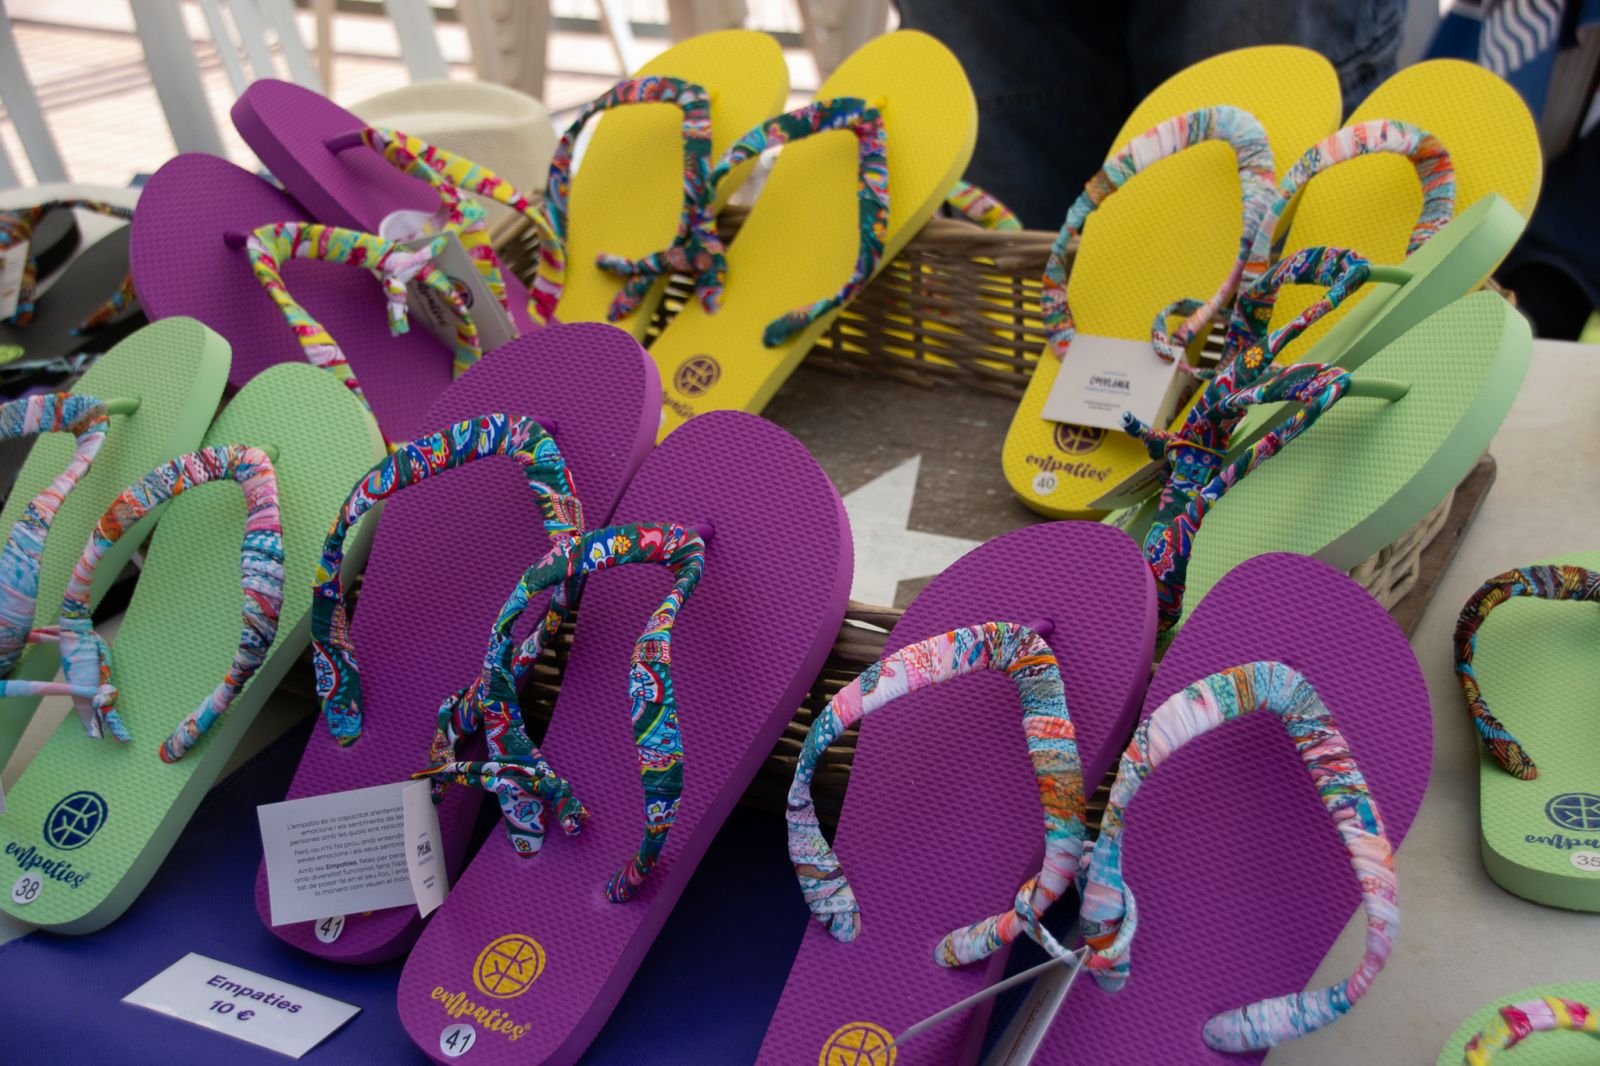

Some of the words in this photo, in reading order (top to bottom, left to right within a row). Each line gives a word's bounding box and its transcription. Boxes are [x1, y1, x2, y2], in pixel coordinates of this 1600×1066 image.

[1036, 476, 1056, 490] 40
[337, 811, 369, 822] capacitat
[369, 806, 404, 817] d'entendr
[289, 836, 321, 847] persones
[321, 832, 337, 842] amb
[347, 828, 366, 838] quals
[380, 822, 404, 831] relacio
[300, 825, 333, 836] emocions
[347, 817, 384, 829] sentiments
[385, 815, 395, 823] de
[316, 849, 349, 860] emocions
[379, 840, 405, 850] sentime
[333, 841, 344, 850] ha
[344, 840, 360, 849] prou
[360, 836, 377, 846] amb
[376, 832, 405, 843] entendr
[1524, 833, 1600, 850] empa
[297, 866, 314, 875] Amb
[376, 854, 389, 863] per
[1576, 854, 1600, 868] 35
[293, 875, 310, 884] amb
[310, 869, 342, 881] diversitat
[15, 877, 40, 900] 38
[321, 885, 349, 895] manera
[349, 882, 365, 891] com
[320, 916, 343, 938] 41
[206, 974, 302, 1014] Empaties
[209, 1000, 236, 1014] 10
[236, 1009, 256, 1021] €
[445, 1028, 473, 1054] 41
